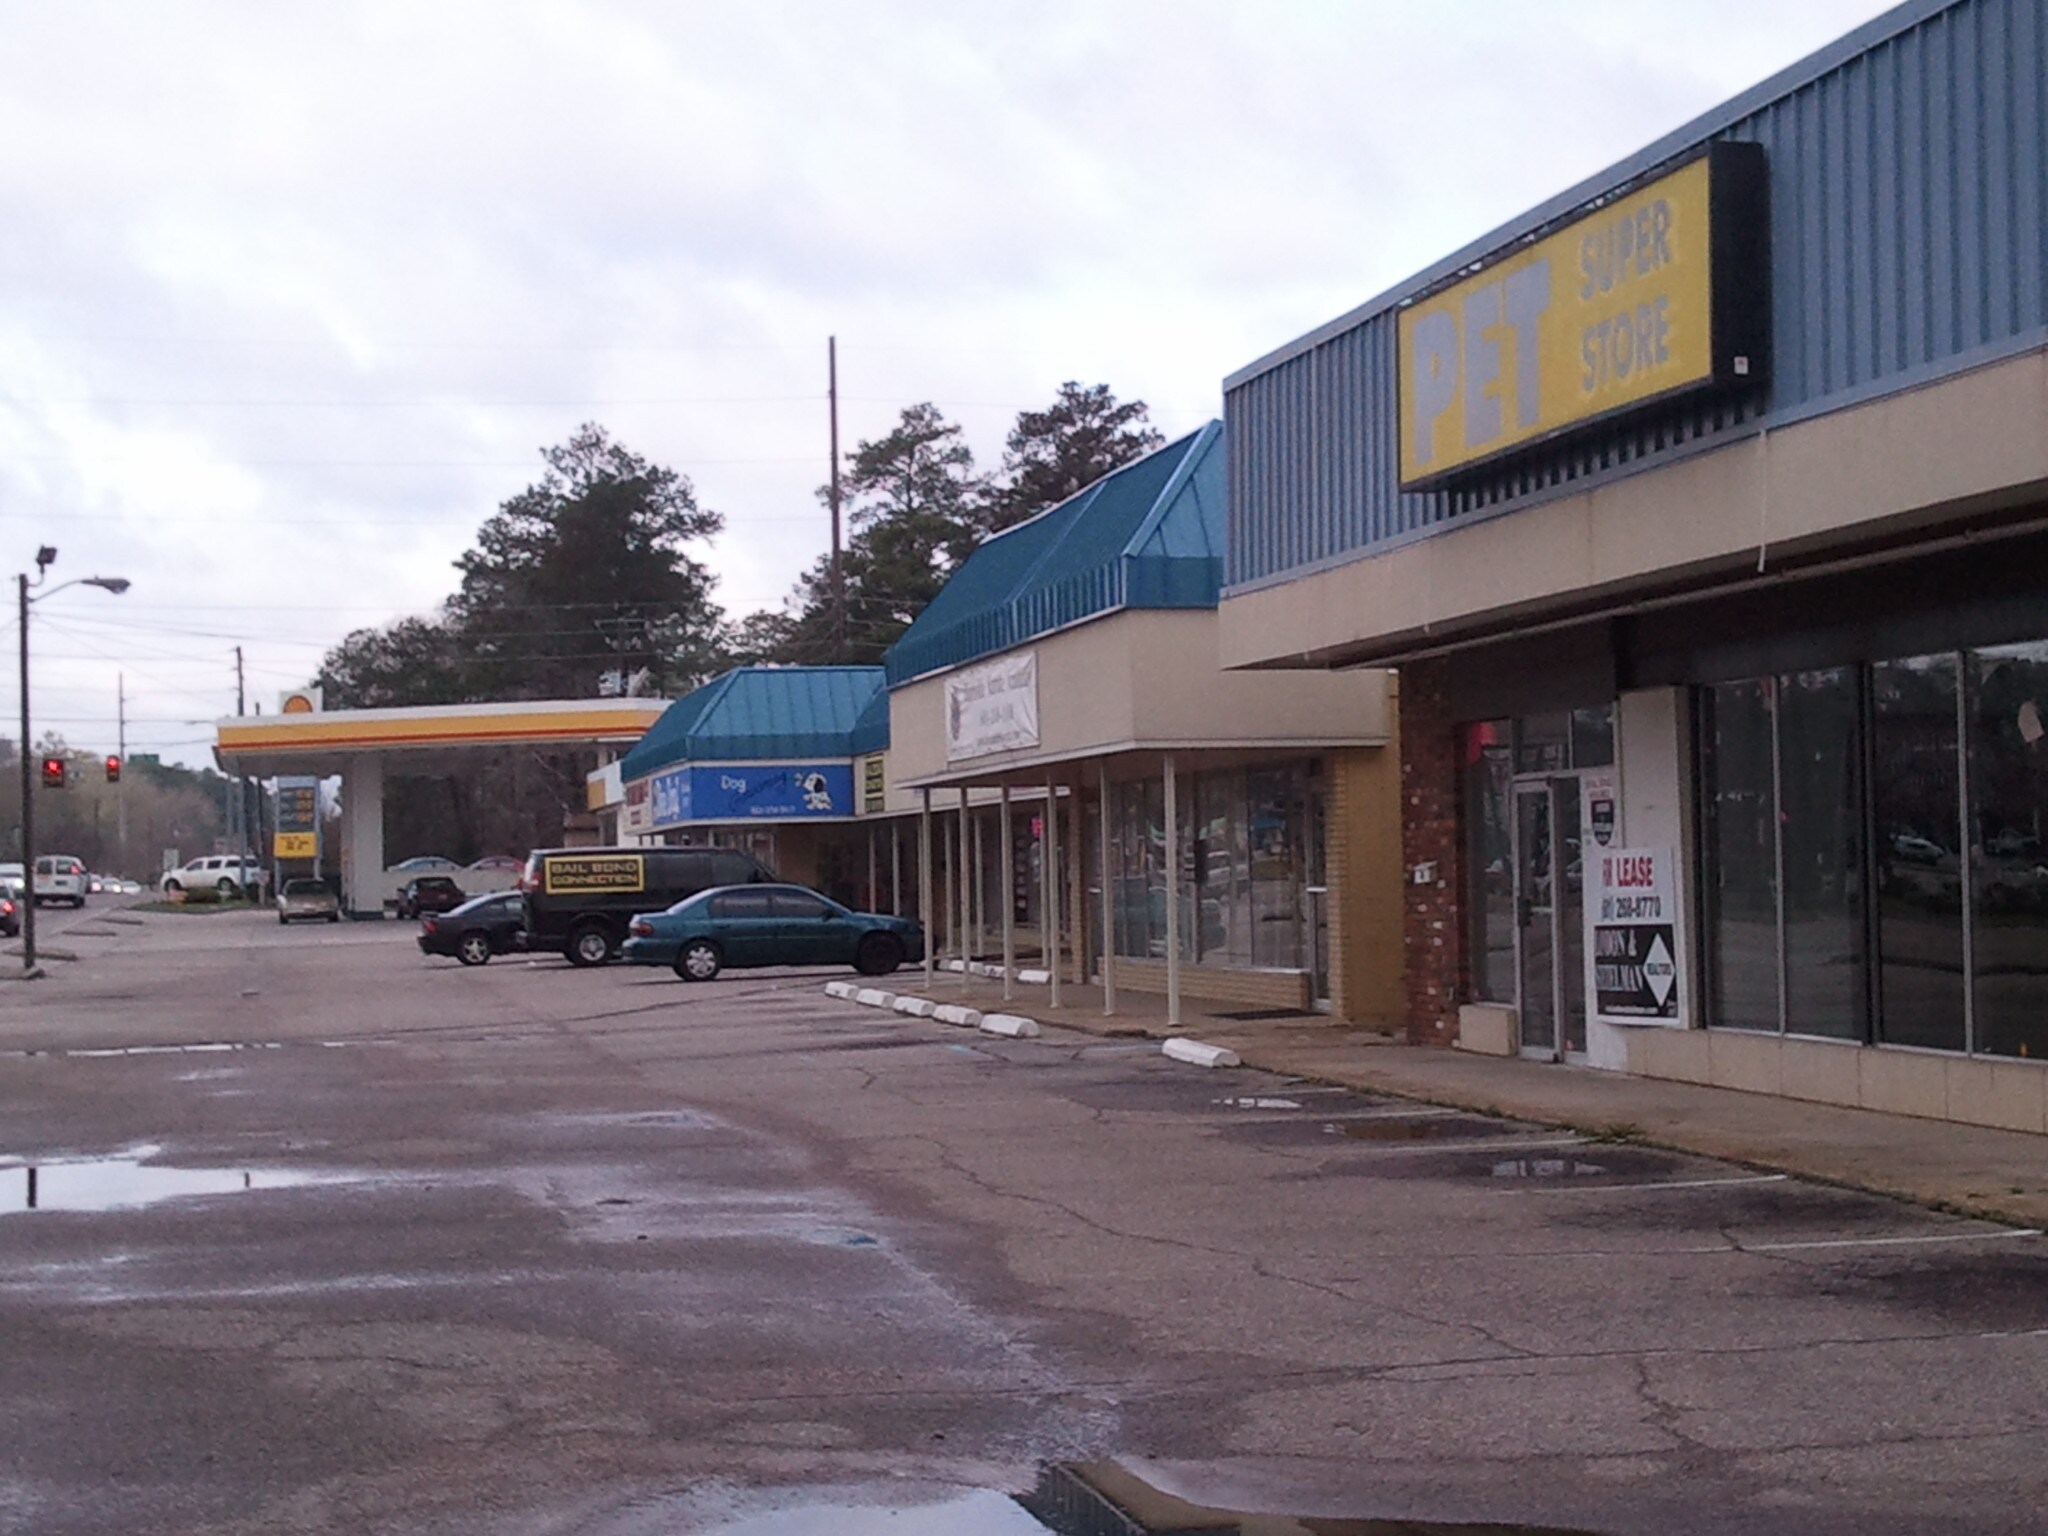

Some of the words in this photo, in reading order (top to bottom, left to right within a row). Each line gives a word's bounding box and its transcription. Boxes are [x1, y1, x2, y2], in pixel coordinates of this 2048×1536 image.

[1580, 198, 1671, 301] SUPER
[1581, 295, 1669, 397] STORE
[1412, 259, 1552, 465] PET
[721, 775, 746, 793] Dog
[551, 863, 588, 874] BAIL
[592, 862, 638, 873] BOND
[551, 873, 638, 885] CONNECTION
[1616, 857, 1653, 887] LEASE
